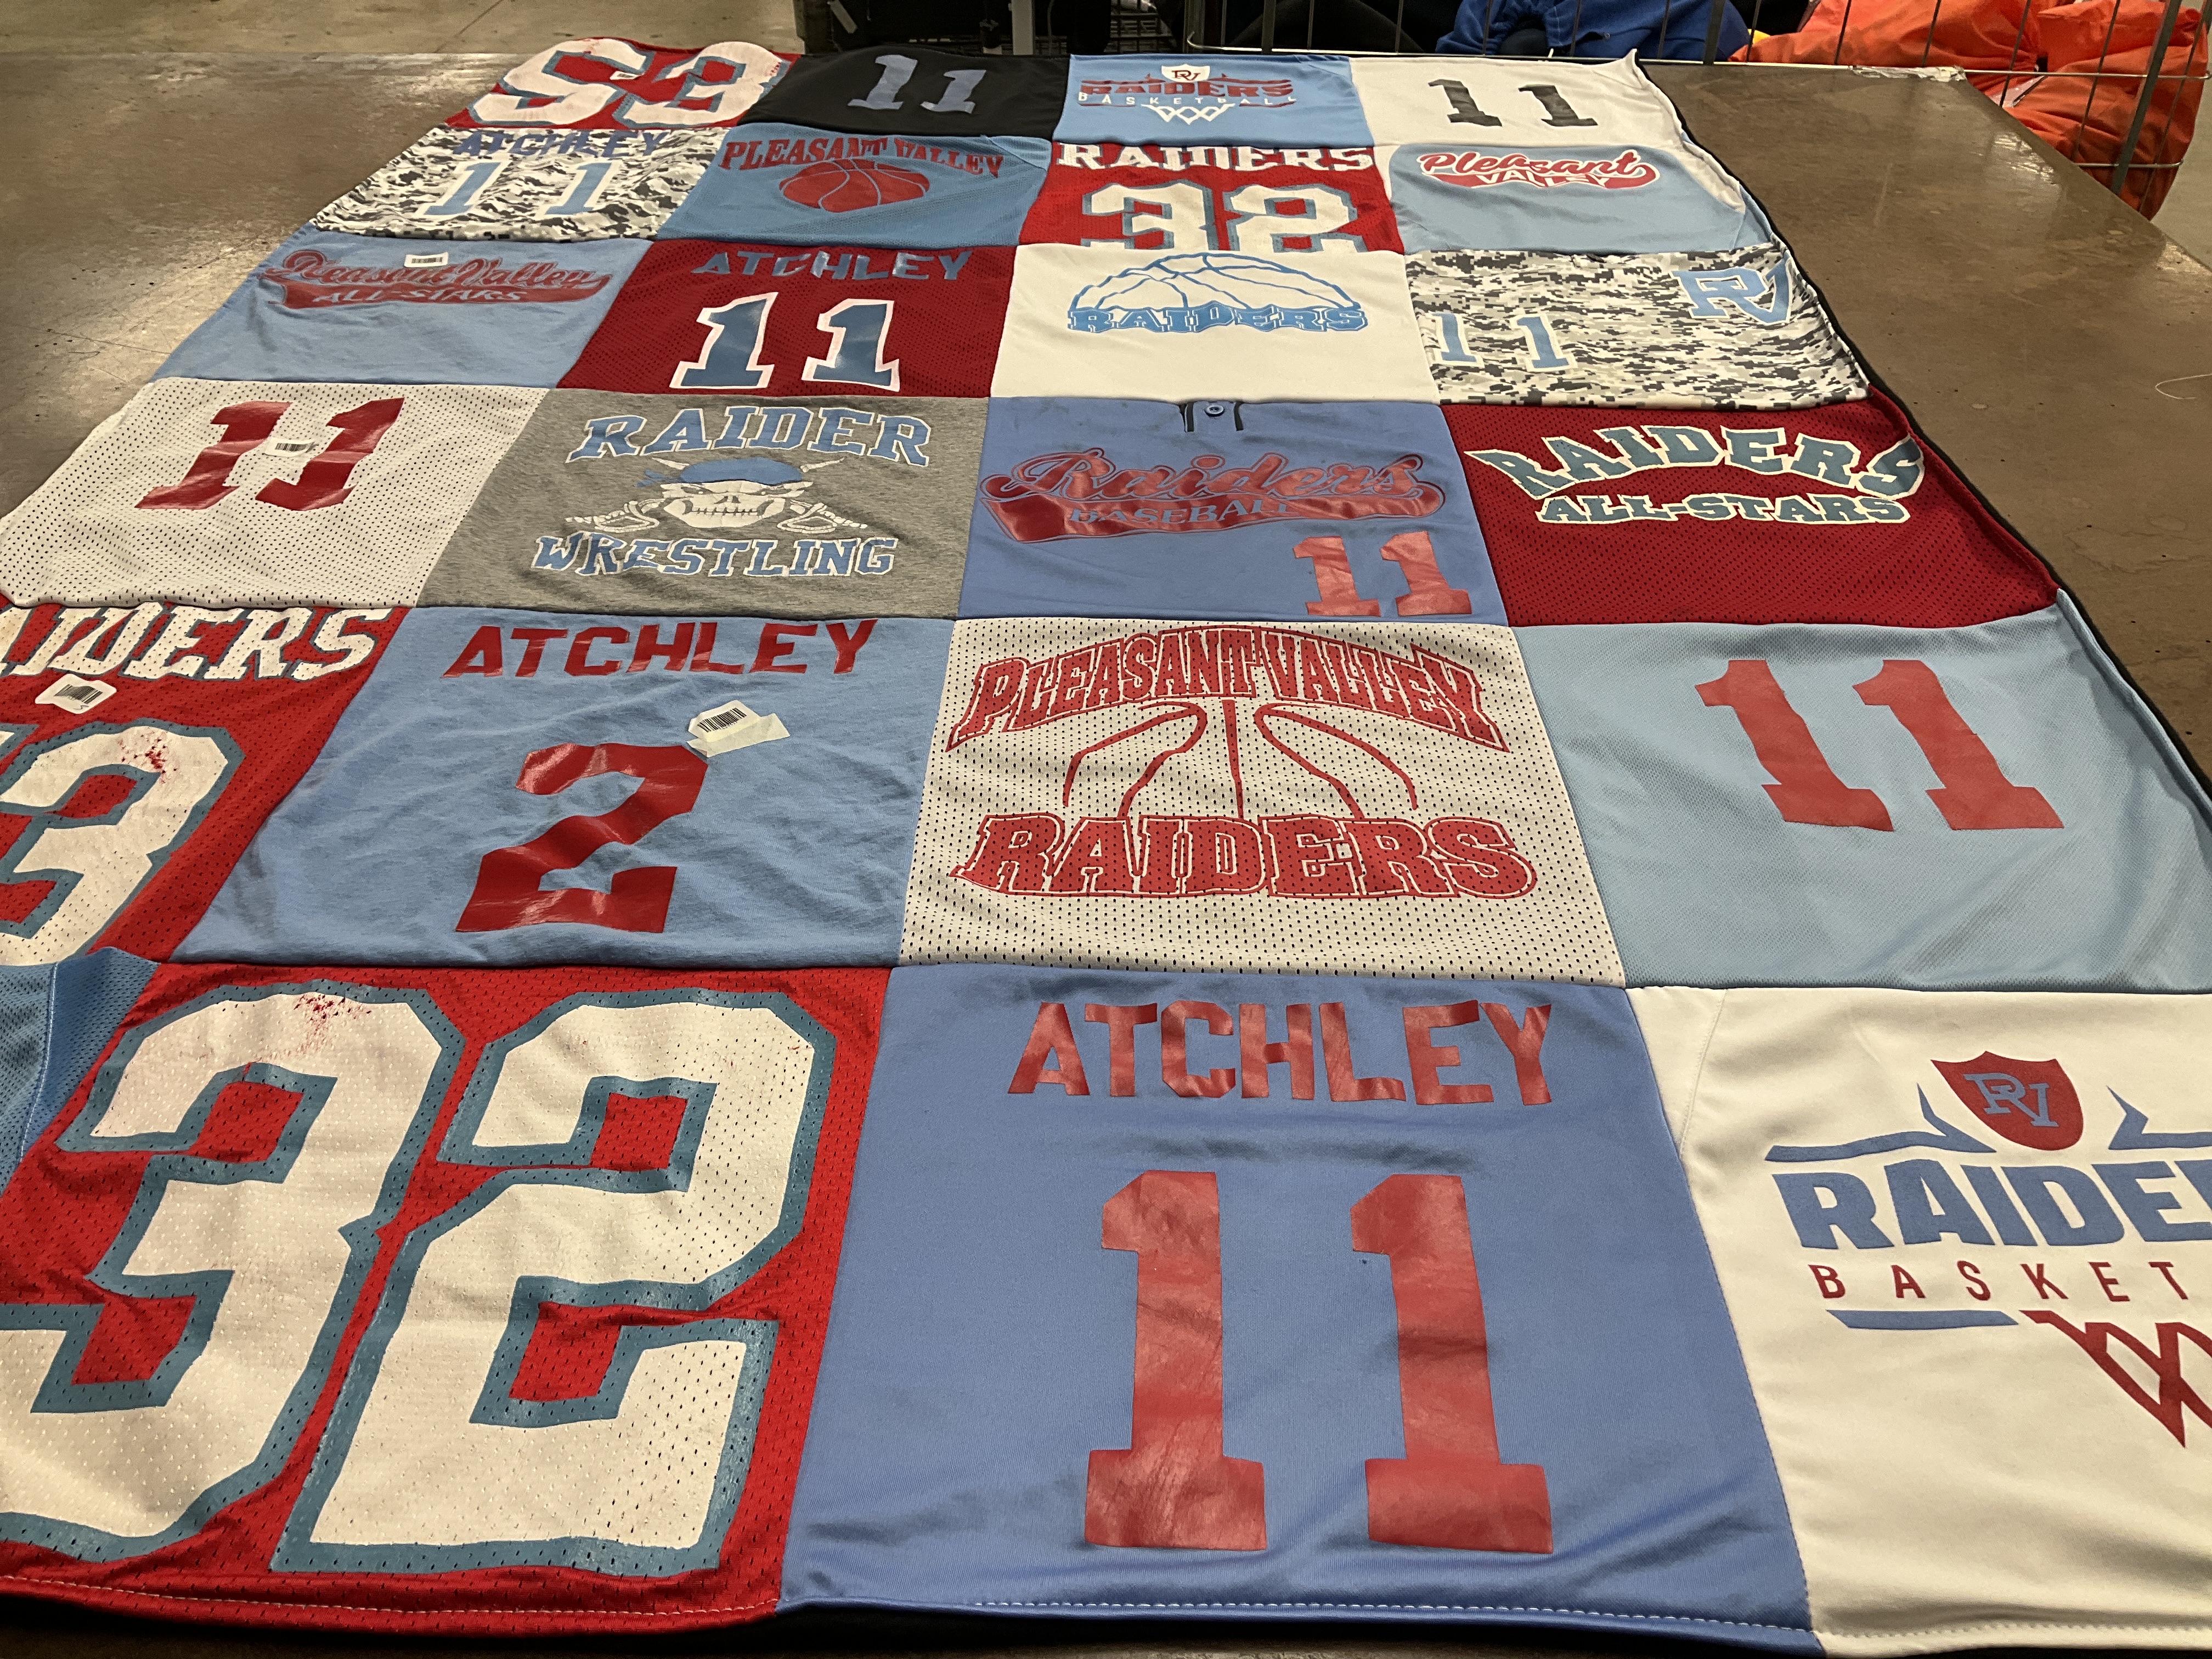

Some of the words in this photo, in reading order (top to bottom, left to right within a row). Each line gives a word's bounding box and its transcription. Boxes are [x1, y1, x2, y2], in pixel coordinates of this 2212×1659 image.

[847, 54, 986, 114] 11
[1080, 82, 1294, 97] RAIDERS
[1427, 78, 1599, 127] 11
[453, 130, 669, 159] ATCHLEY
[718, 137, 888, 171] PLEASANT
[894, 138, 1004, 179] VALLEY
[1056, 142, 1375, 171] RAIDERS
[1417, 149, 1645, 177] Pleasant
[416, 160, 623, 217] 11
[1081, 179, 1370, 253] 32
[691, 250, 973, 281] ATCHLEY
[669, 291, 900, 392] 11
[1067, 300, 1369, 333] RAIDERS
[1426, 311, 1577, 373] 11
[134, 397, 405, 511] 11
[565, 405, 932, 467] RAIDER
[1464, 424, 1926, 499] RAIDERS
[980, 447, 1426, 502] Raiders
[1536, 492, 1911, 524] ALL-STARS
[530, 531, 899, 578] WRESTLING
[1293, 530, 1472, 617] 11
[441, 618, 879, 679] ATCHLEY
[946, 625, 1261, 753] PLEASANT
[1260, 627, 1510, 753] VALLEY
[1694, 659, 2064, 832] 11
[455, 742, 709, 934] 2
[949, 812, 1537, 898] RAIDERS
[1008, 1000, 1552, 1107] ATCHLEY
[0, 979, 837, 1579] 32
[1807, 1260, 2189, 1302] BASKET
[1084, 1169, 1554, 1554] 11
